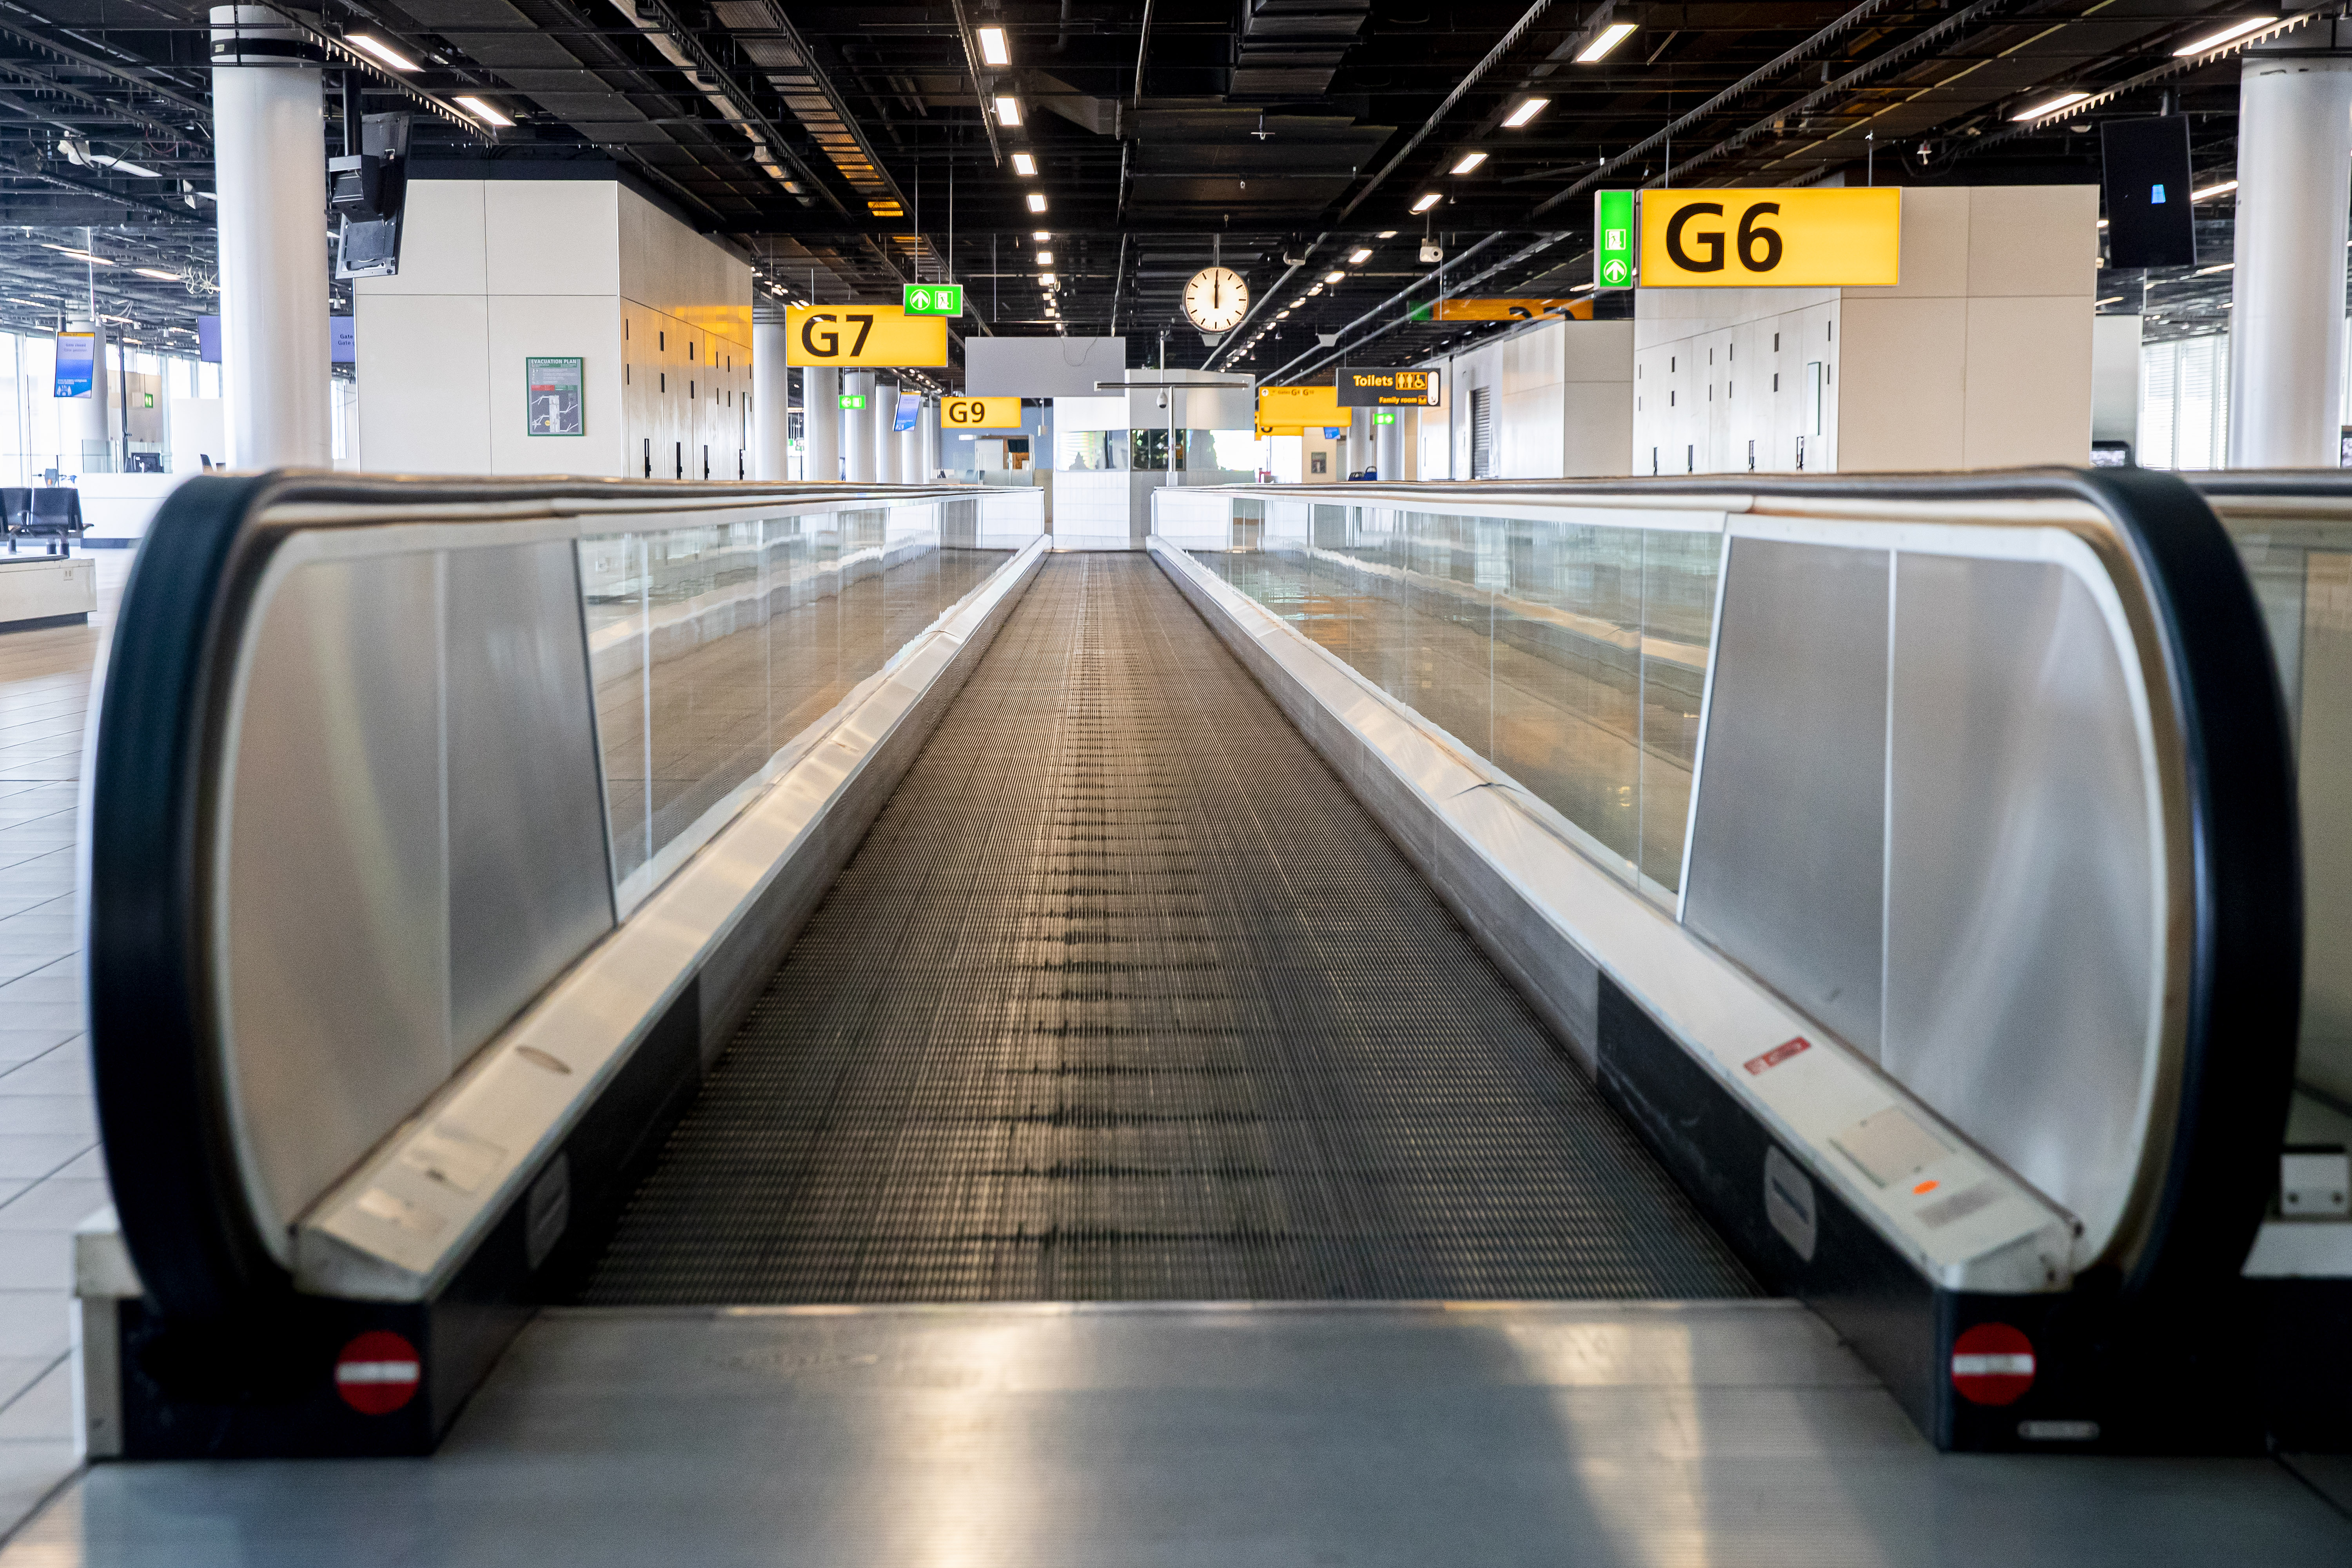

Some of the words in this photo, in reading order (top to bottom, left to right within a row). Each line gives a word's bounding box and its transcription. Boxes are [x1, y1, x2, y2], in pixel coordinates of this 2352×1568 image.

[1666, 202, 1783, 272] G6
[802, 314, 873, 357] G7
[1353, 374, 1393, 387] Toilets
[1379, 396, 1400, 405] Family
[949, 402, 985, 423] G9
